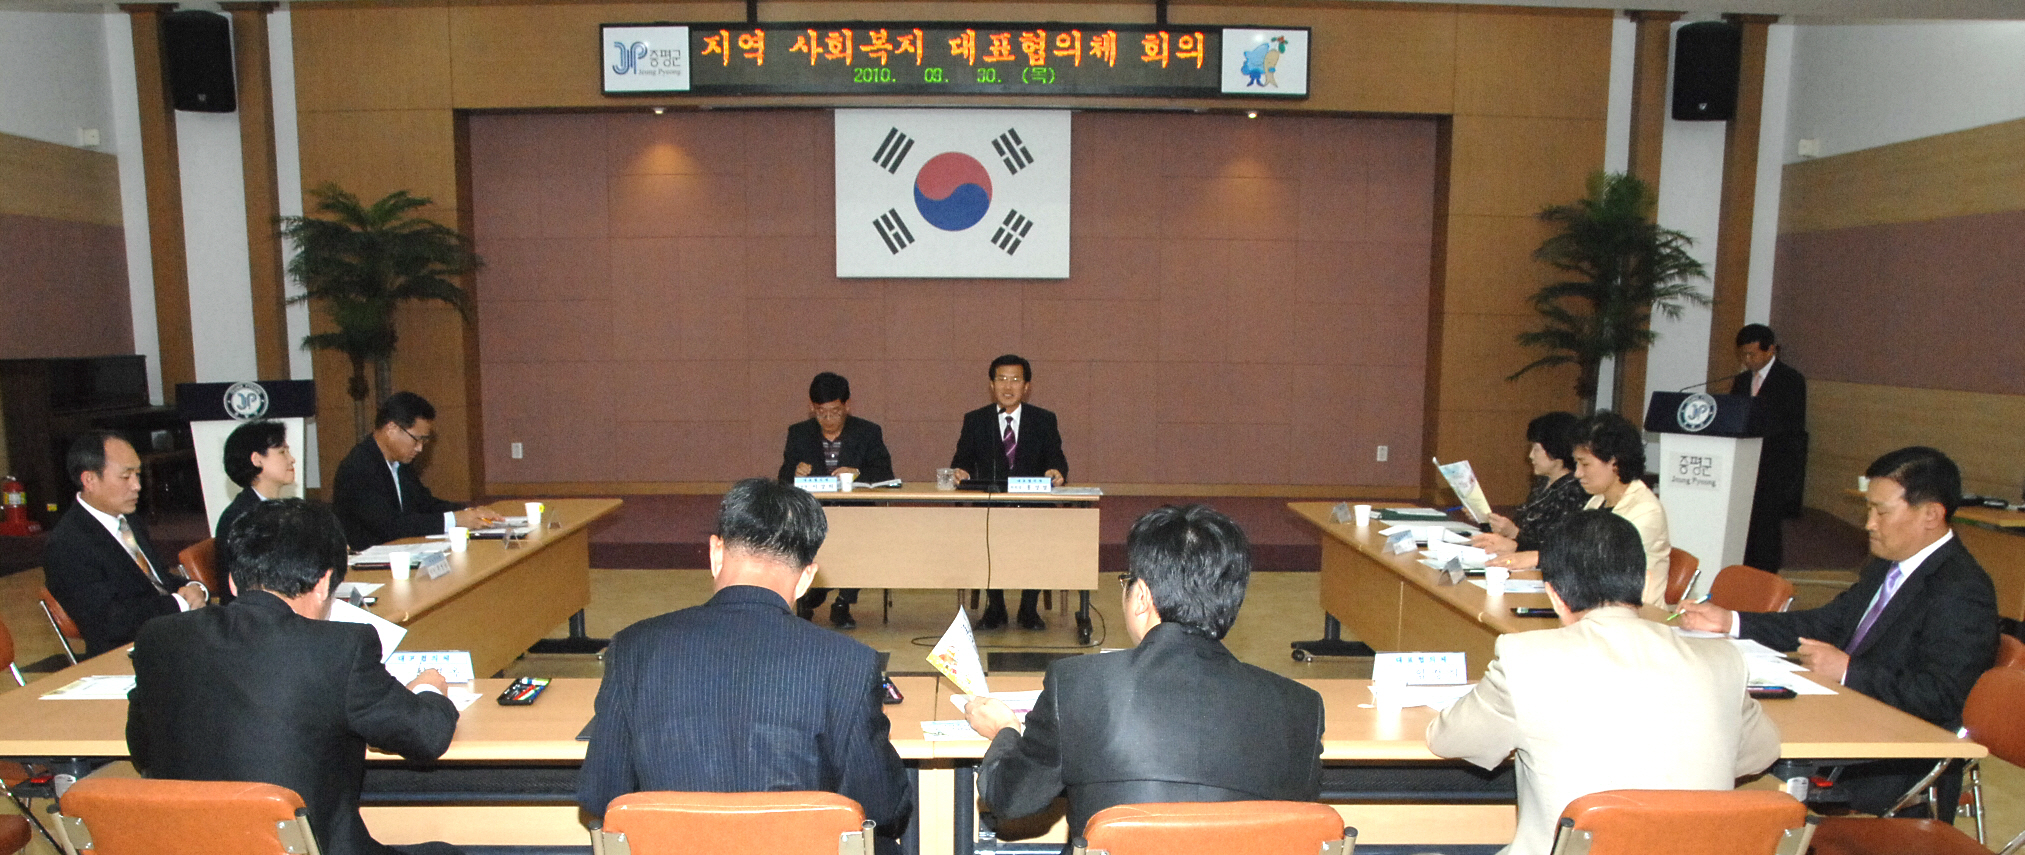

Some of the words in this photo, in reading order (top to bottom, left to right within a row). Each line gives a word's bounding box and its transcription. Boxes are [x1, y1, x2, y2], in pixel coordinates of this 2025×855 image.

[649, 49, 681, 67] 증평군
[701, 28, 766, 67] 지역
[788, 27, 924, 66] 사회복지
[948, 28, 1118, 68] 대표협의체
[1140, 30, 1205, 69] 회의
[854, 67, 897, 83] 2010.
[976, 67, 1002, 83] 30.
[1022, 67, 1056, 85] (목)
[1679, 455, 1713, 477] 증평군
